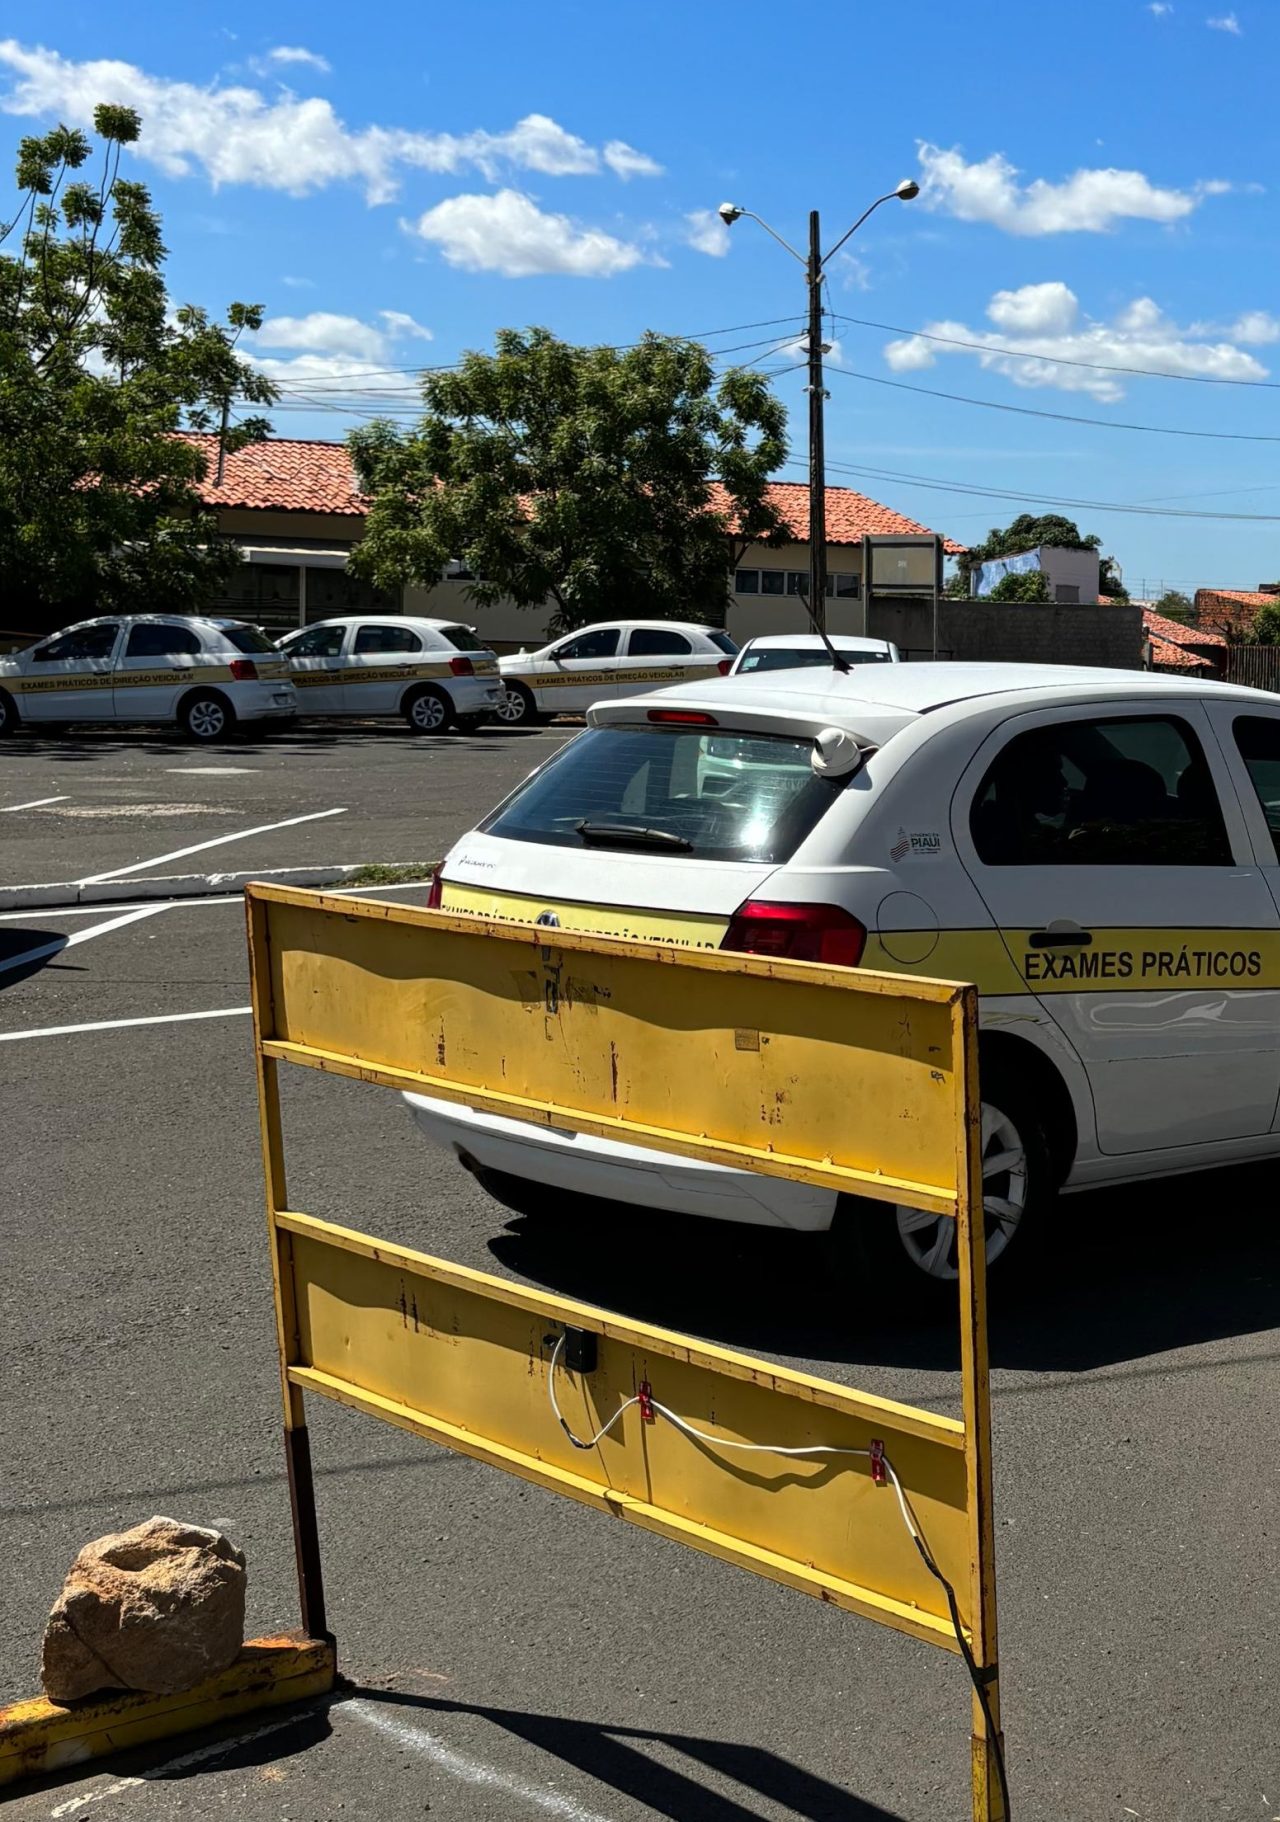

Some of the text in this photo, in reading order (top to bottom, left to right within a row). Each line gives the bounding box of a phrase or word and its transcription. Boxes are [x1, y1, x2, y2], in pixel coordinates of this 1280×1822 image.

[21, 673, 194, 690] EXAMES PRÁTICOS DE DIREÇÃO VEICULAR
[537, 670, 685, 685] EXAMES PRÁTICOS DE DIREÇÃO VEICULAR
[1024, 952, 1133, 980] EXAMES
[1141, 945, 1261, 978] PRÁTICOS
